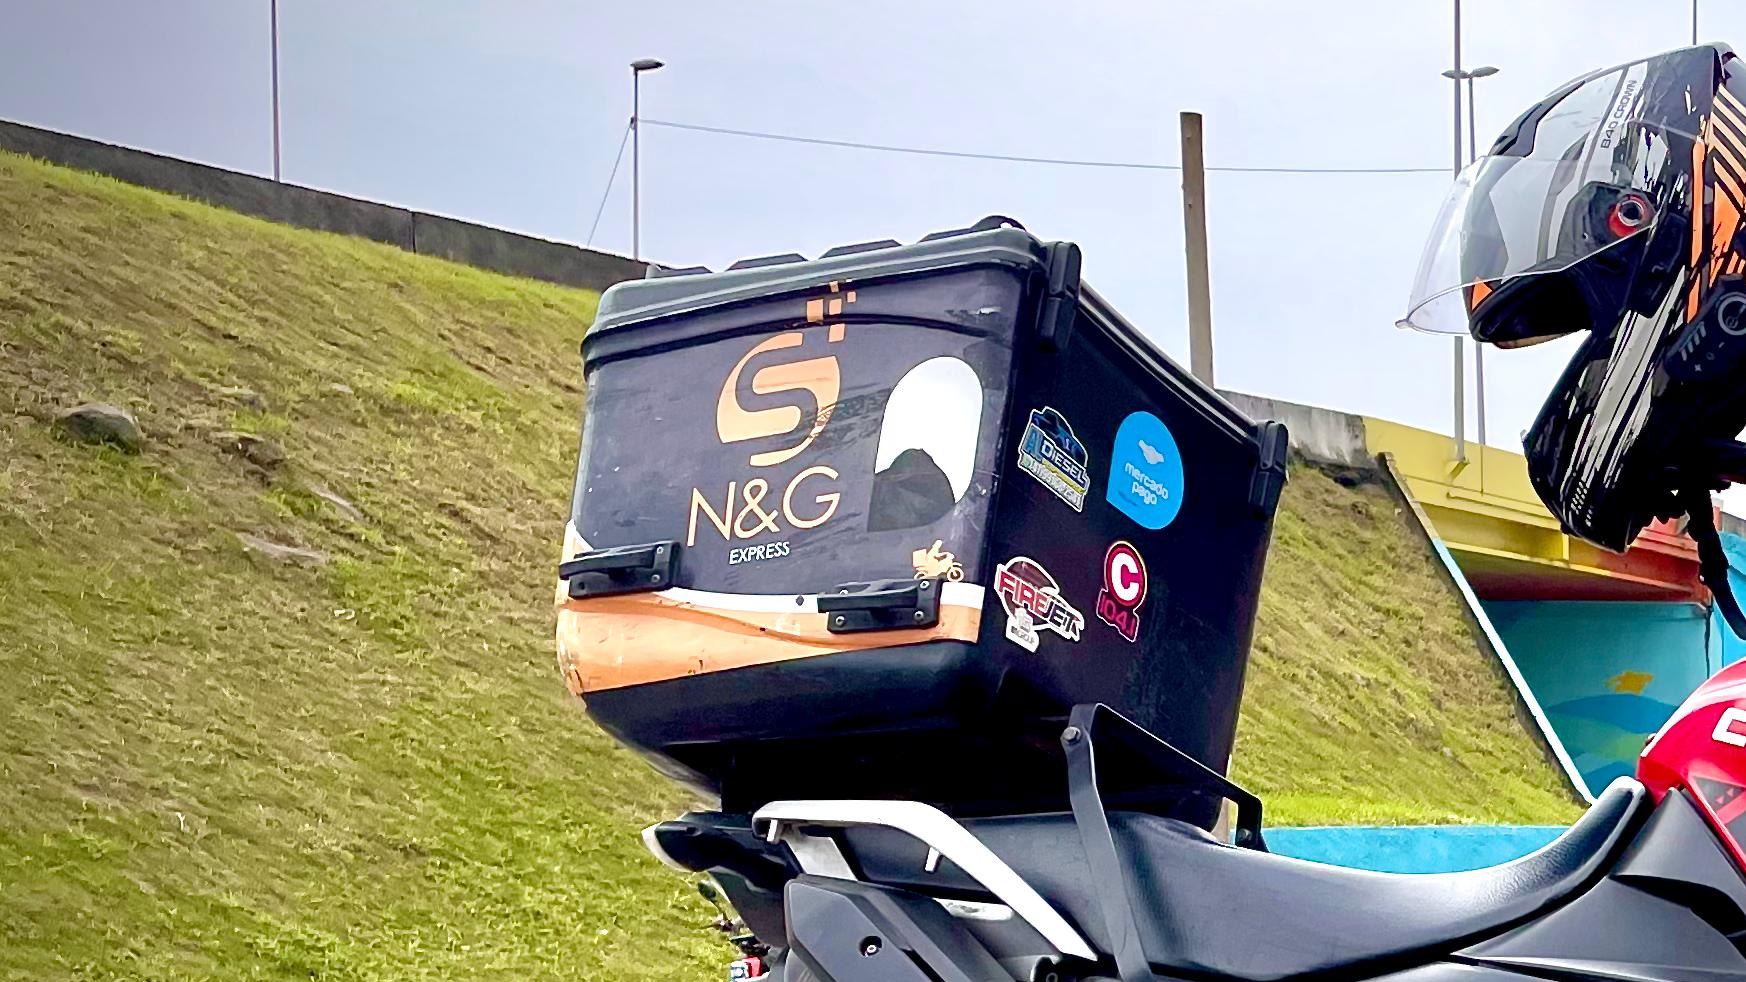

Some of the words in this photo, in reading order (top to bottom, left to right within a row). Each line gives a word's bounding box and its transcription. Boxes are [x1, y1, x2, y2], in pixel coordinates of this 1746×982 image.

[1041, 439, 1087, 484] DIESEL
[1124, 462, 1169, 500] mercado
[1131, 481, 1158, 505] pago
[686, 465, 841, 547] N&G
[728, 541, 791, 565] EXPRESS
